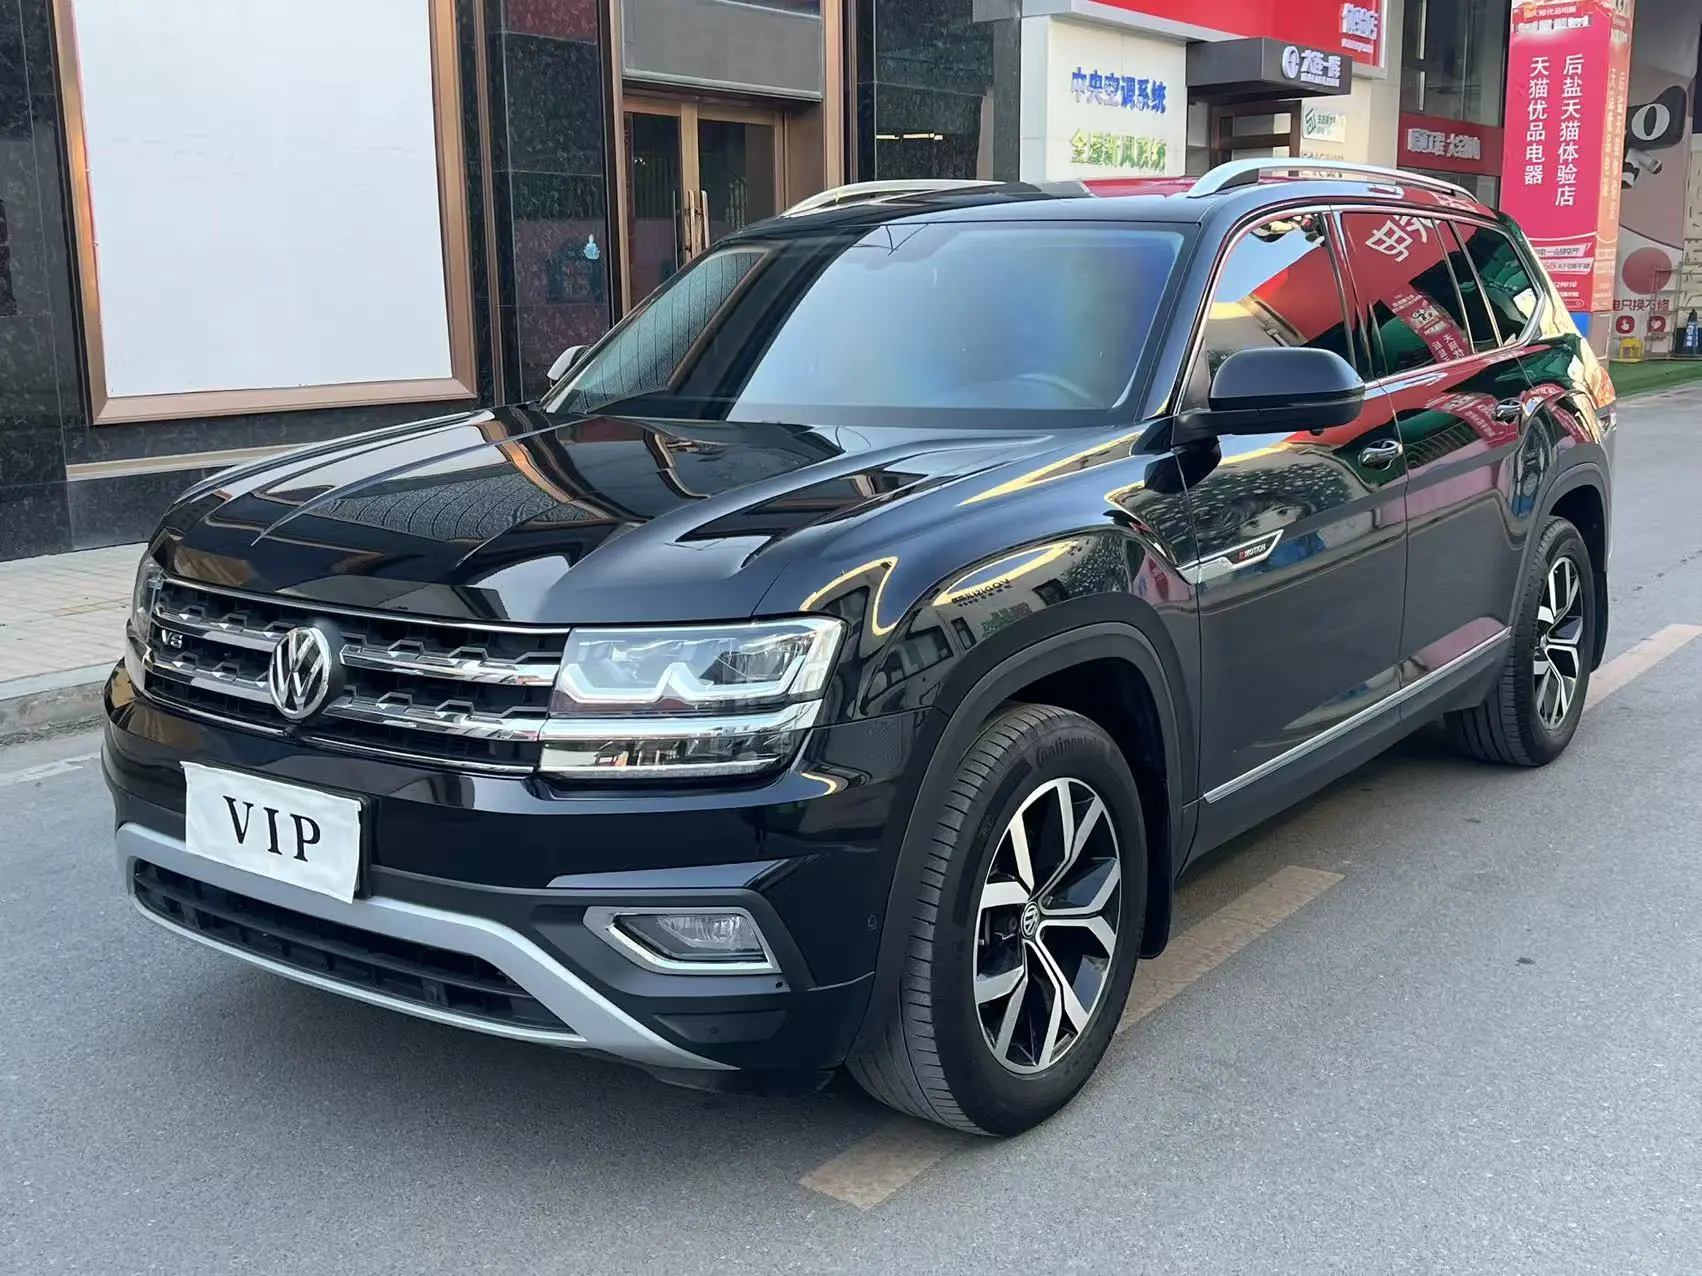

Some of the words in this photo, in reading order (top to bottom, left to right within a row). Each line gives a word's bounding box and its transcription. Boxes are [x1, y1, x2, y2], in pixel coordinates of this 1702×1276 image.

[1071, 66, 1167, 114] 中央空调系统
[1523, 56, 1550, 185] 天猫优品电器
[1555, 54, 1585, 206] 后盐天猫体验店
[222, 795, 322, 863] VIP
